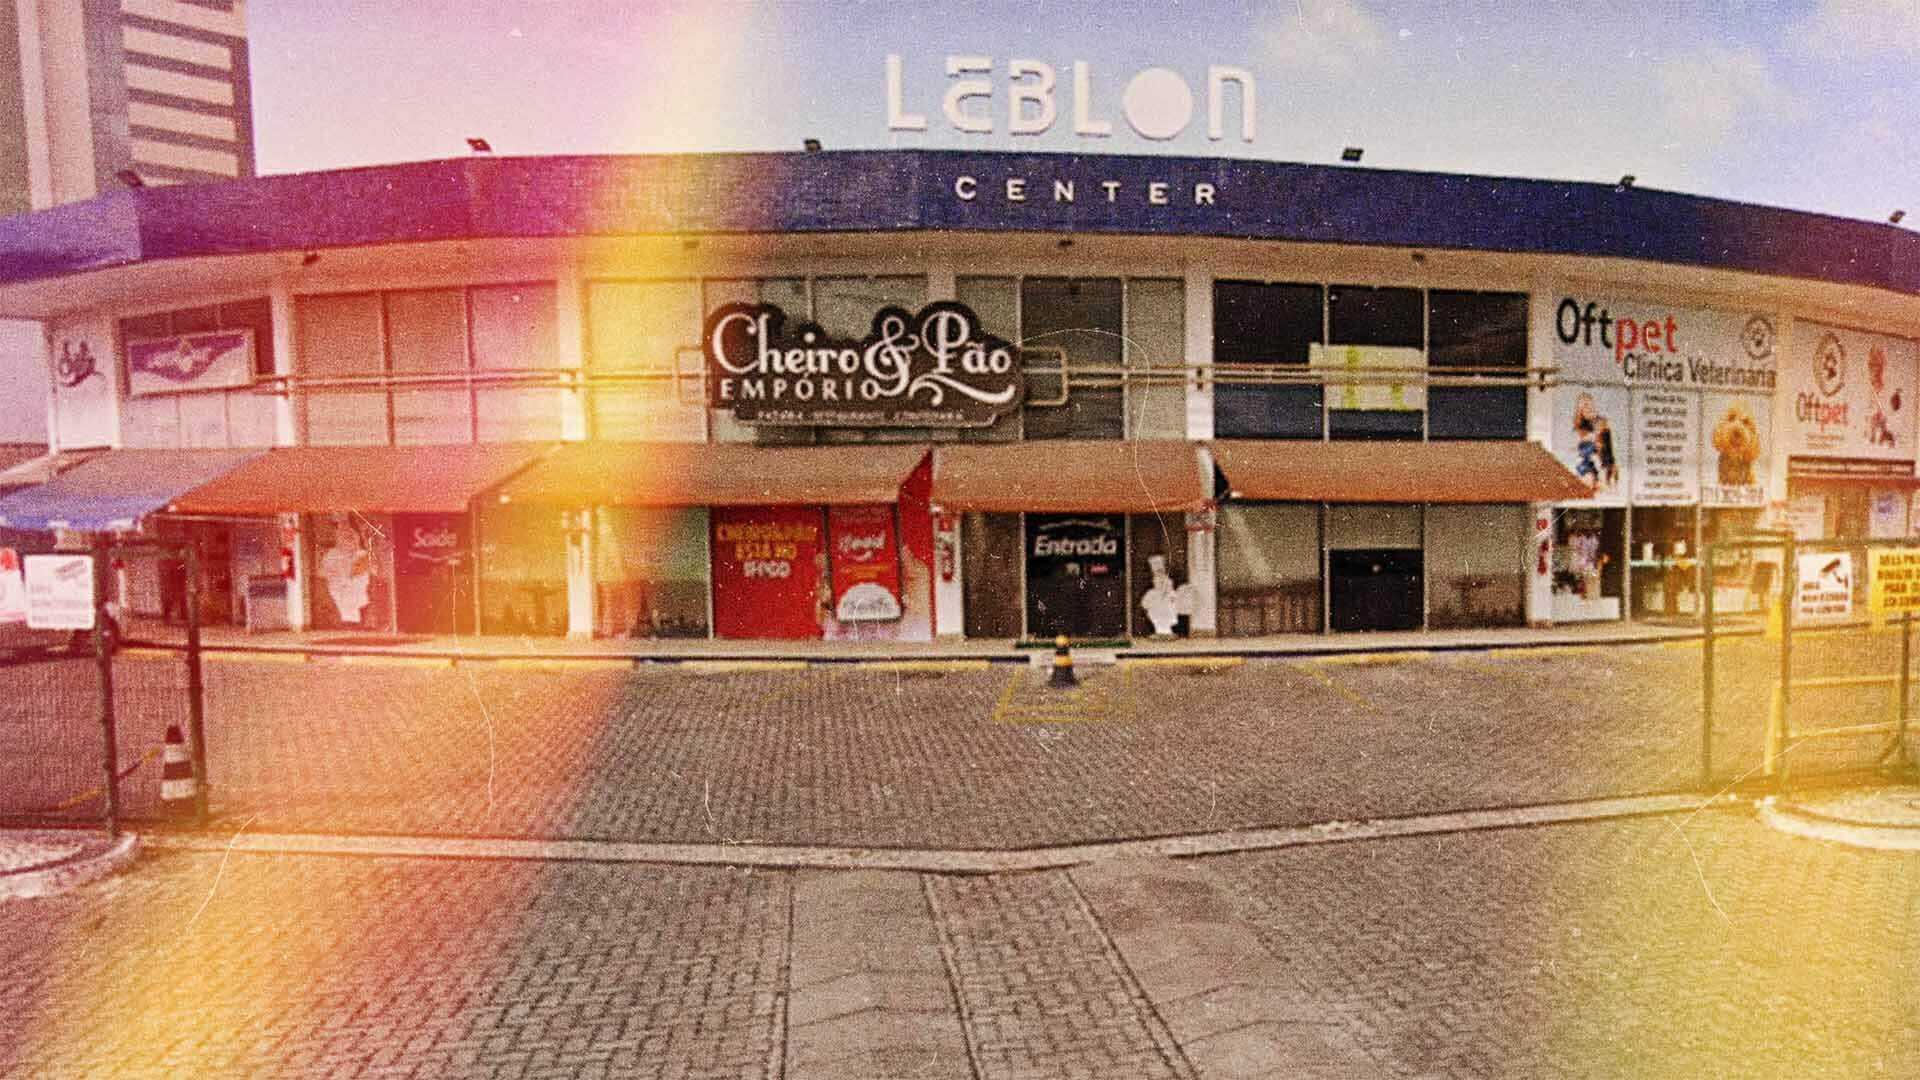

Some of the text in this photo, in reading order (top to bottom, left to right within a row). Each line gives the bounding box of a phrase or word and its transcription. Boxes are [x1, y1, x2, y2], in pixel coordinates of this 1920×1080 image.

[954, 175, 1217, 206] CENTER
[1556, 298, 1679, 363] Oftpet
[712, 309, 1012, 397] Cheiro & Pão
[720, 370, 880, 401] EMPÓRIO
[1034, 534, 1118, 556] Entrada
